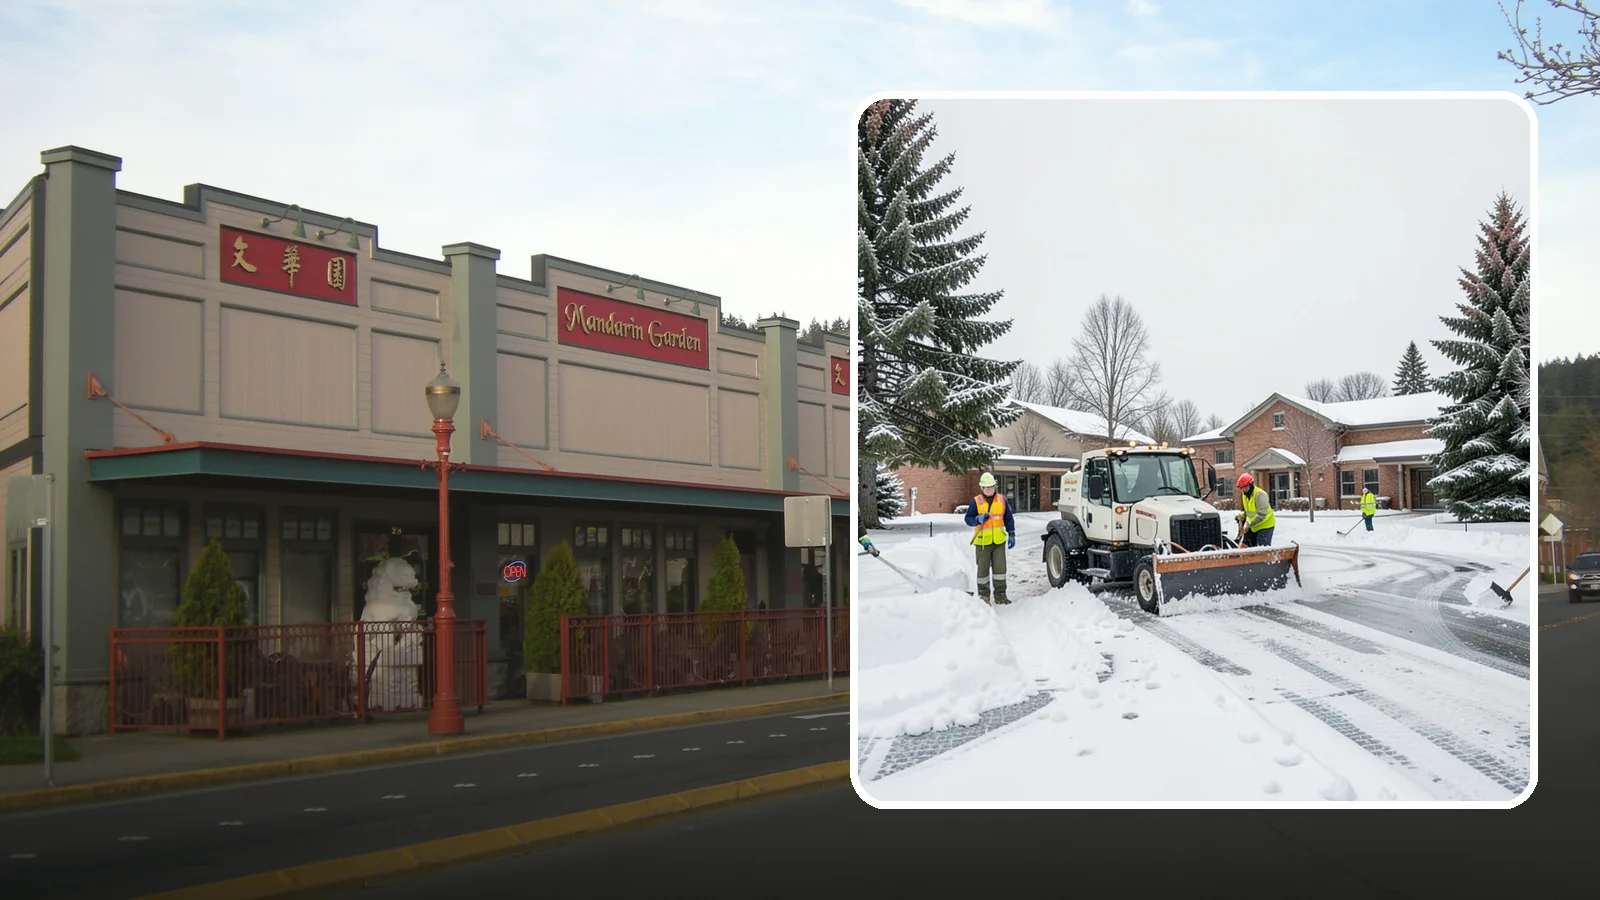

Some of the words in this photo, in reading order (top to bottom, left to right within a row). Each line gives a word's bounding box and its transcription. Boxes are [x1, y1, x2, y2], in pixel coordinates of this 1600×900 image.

[231, 235, 346, 291] 文華園
[564, 302, 643, 341] Mandarin
[648, 320, 701, 352] Garden
[503, 565, 527, 578] OPEN
